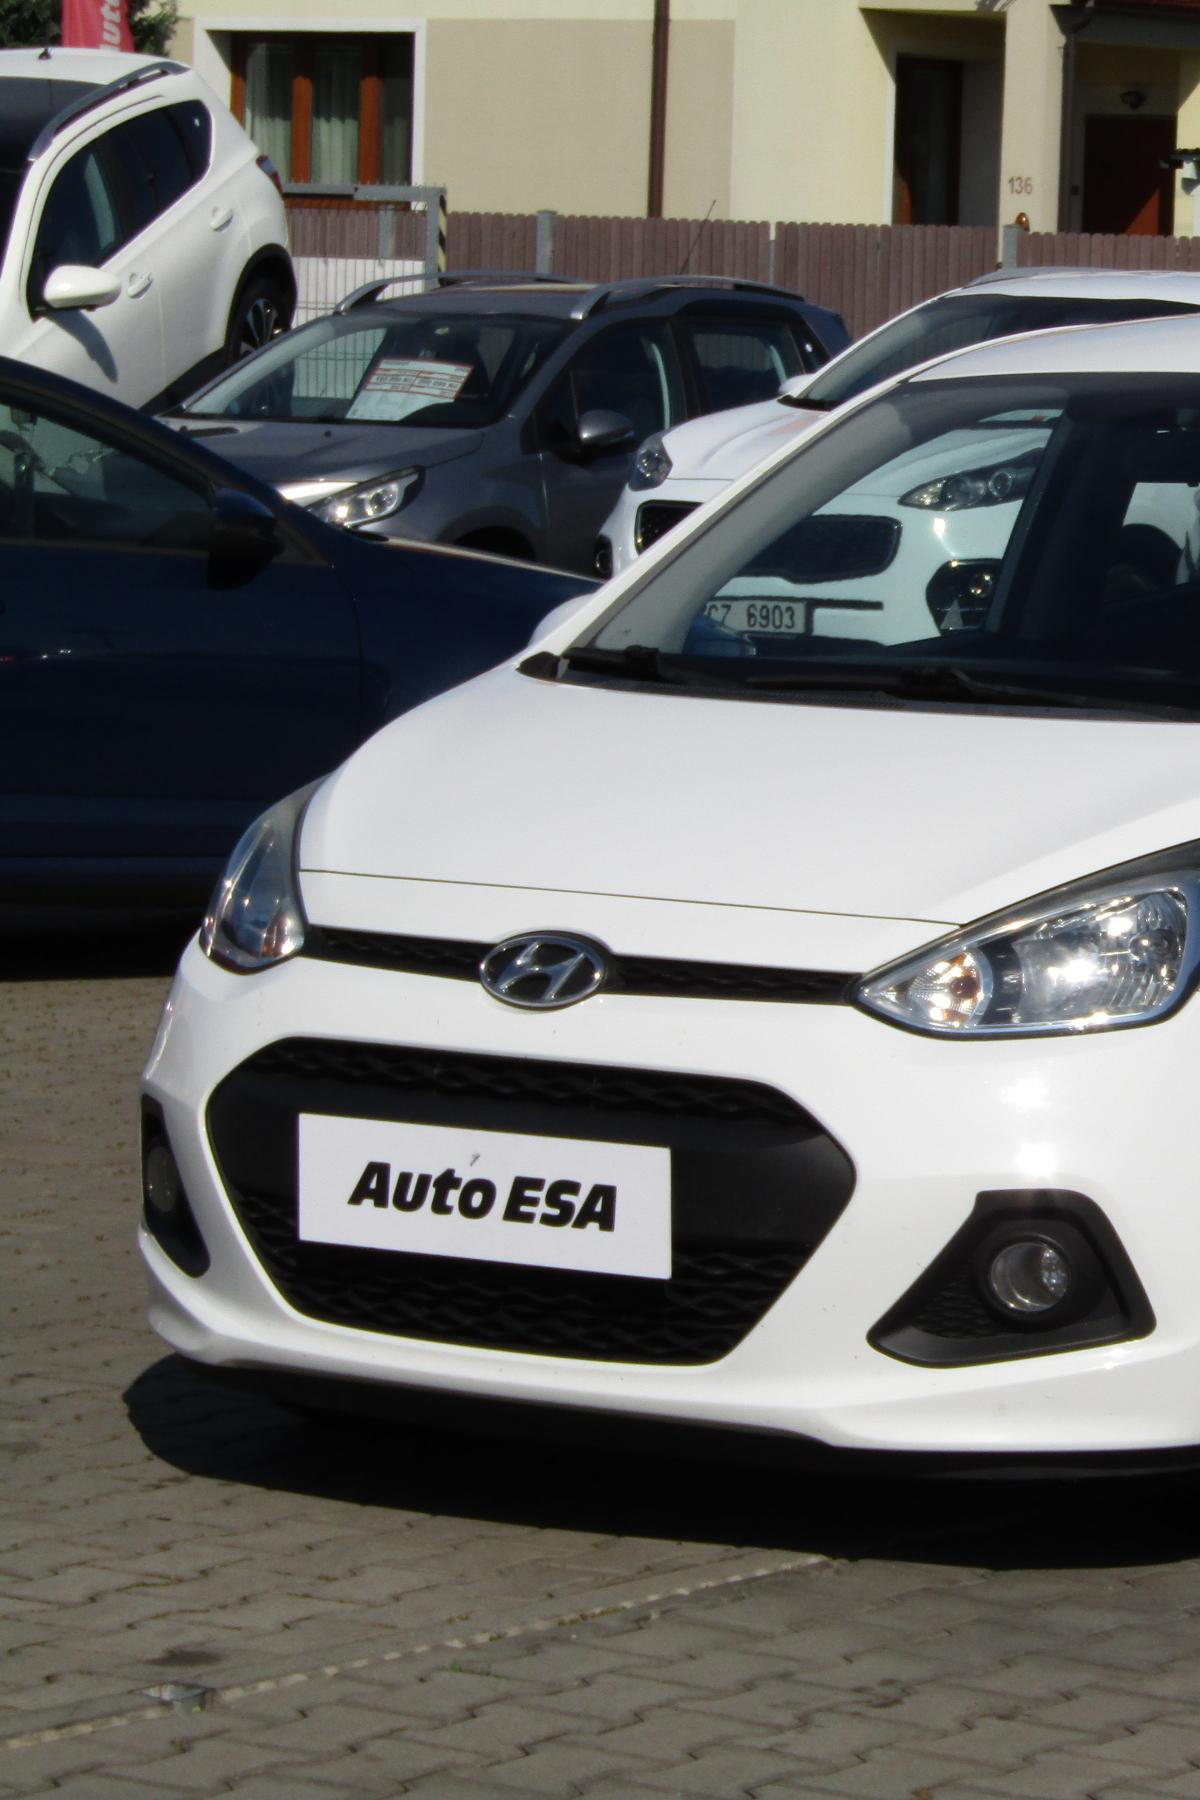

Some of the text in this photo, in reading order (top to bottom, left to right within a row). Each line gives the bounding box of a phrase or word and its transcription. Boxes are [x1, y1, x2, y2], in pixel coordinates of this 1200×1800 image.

[1008, 175, 1033, 195] 136
[746, 603, 795, 629] 6903
[347, 1161, 618, 1232] Auto ESA
